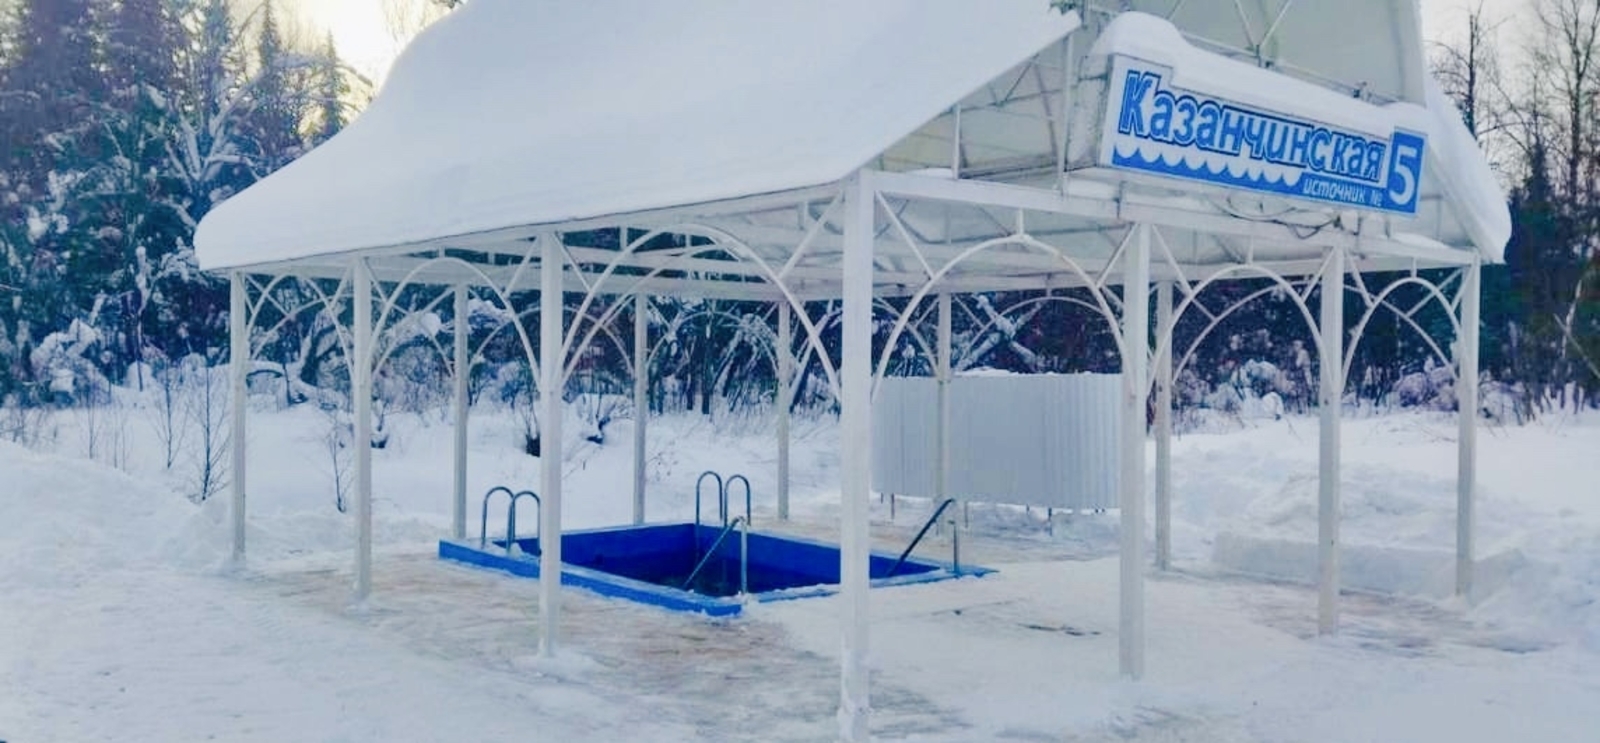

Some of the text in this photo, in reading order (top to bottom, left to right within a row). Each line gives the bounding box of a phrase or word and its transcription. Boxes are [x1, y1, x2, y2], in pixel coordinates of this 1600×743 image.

[1119, 70, 1386, 182] Казанчинская
[1303, 178, 1366, 203] источник
[1389, 144, 1416, 205] 5
